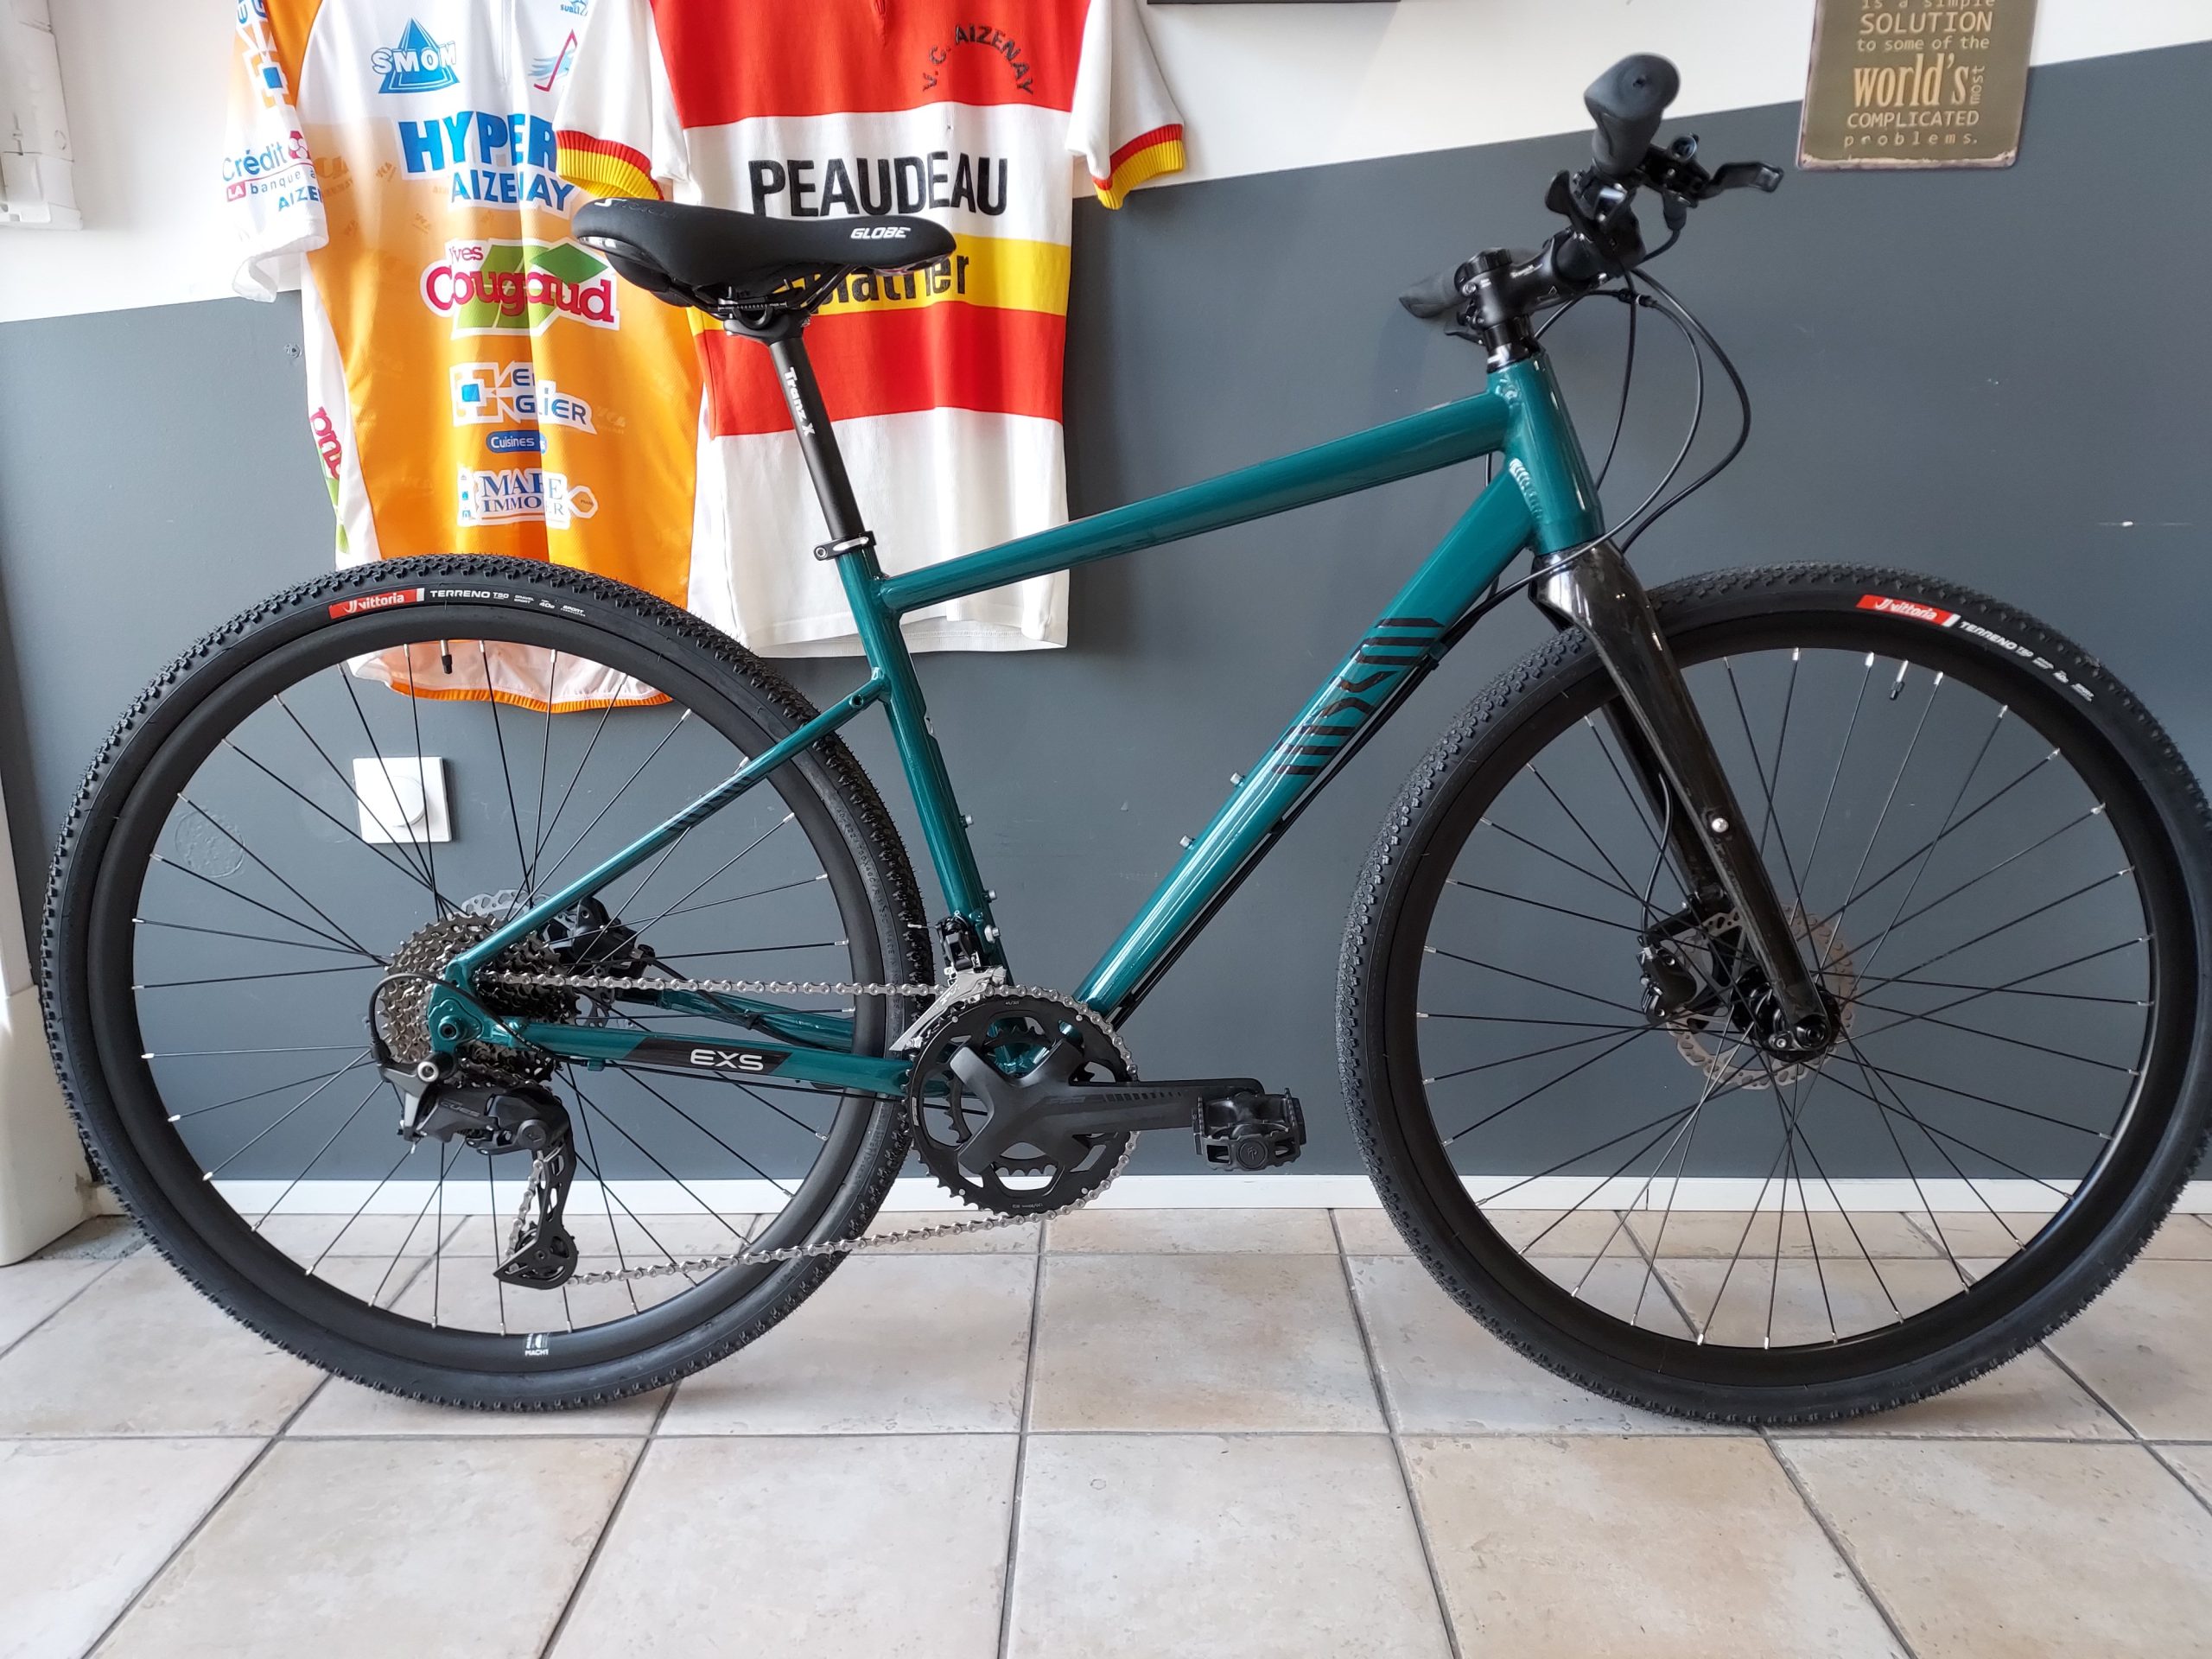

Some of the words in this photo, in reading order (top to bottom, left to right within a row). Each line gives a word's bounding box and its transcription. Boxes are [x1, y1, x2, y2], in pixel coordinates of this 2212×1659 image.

[1859, 11, 1993, 34] SOLUTION
[372, 40, 457, 76] SMOM
[955, 23, 1033, 95] AIZENAY
[1857, 39, 1877, 52] to
[1885, 39, 1924, 51] some
[1931, 35, 1953, 49] of
[1960, 35, 1990, 49] the
[1853, 53, 1969, 108] world's
[1970, 65, 1985, 105] most
[1847, 111, 1980, 128] COMPLICATED
[398, 111, 557, 173] HYPER
[222, 142, 288, 181] Crédit
[227, 183, 245, 201] LA
[250, 170, 302, 195] banque
[451, 169, 577, 207] AIZEAY
[748, 151, 1008, 217] PEAUDEAU
[850, 226, 911, 240] GLOBE
[426, 266, 614, 323] Cougaud
[491, 435, 535, 448] Cuisines
[357, 593, 405, 611] vittoria
[430, 589, 490, 599] TERRENO
[1890, 601, 1937, 620] vittoria
[690, 1048, 764, 1071] EXS
